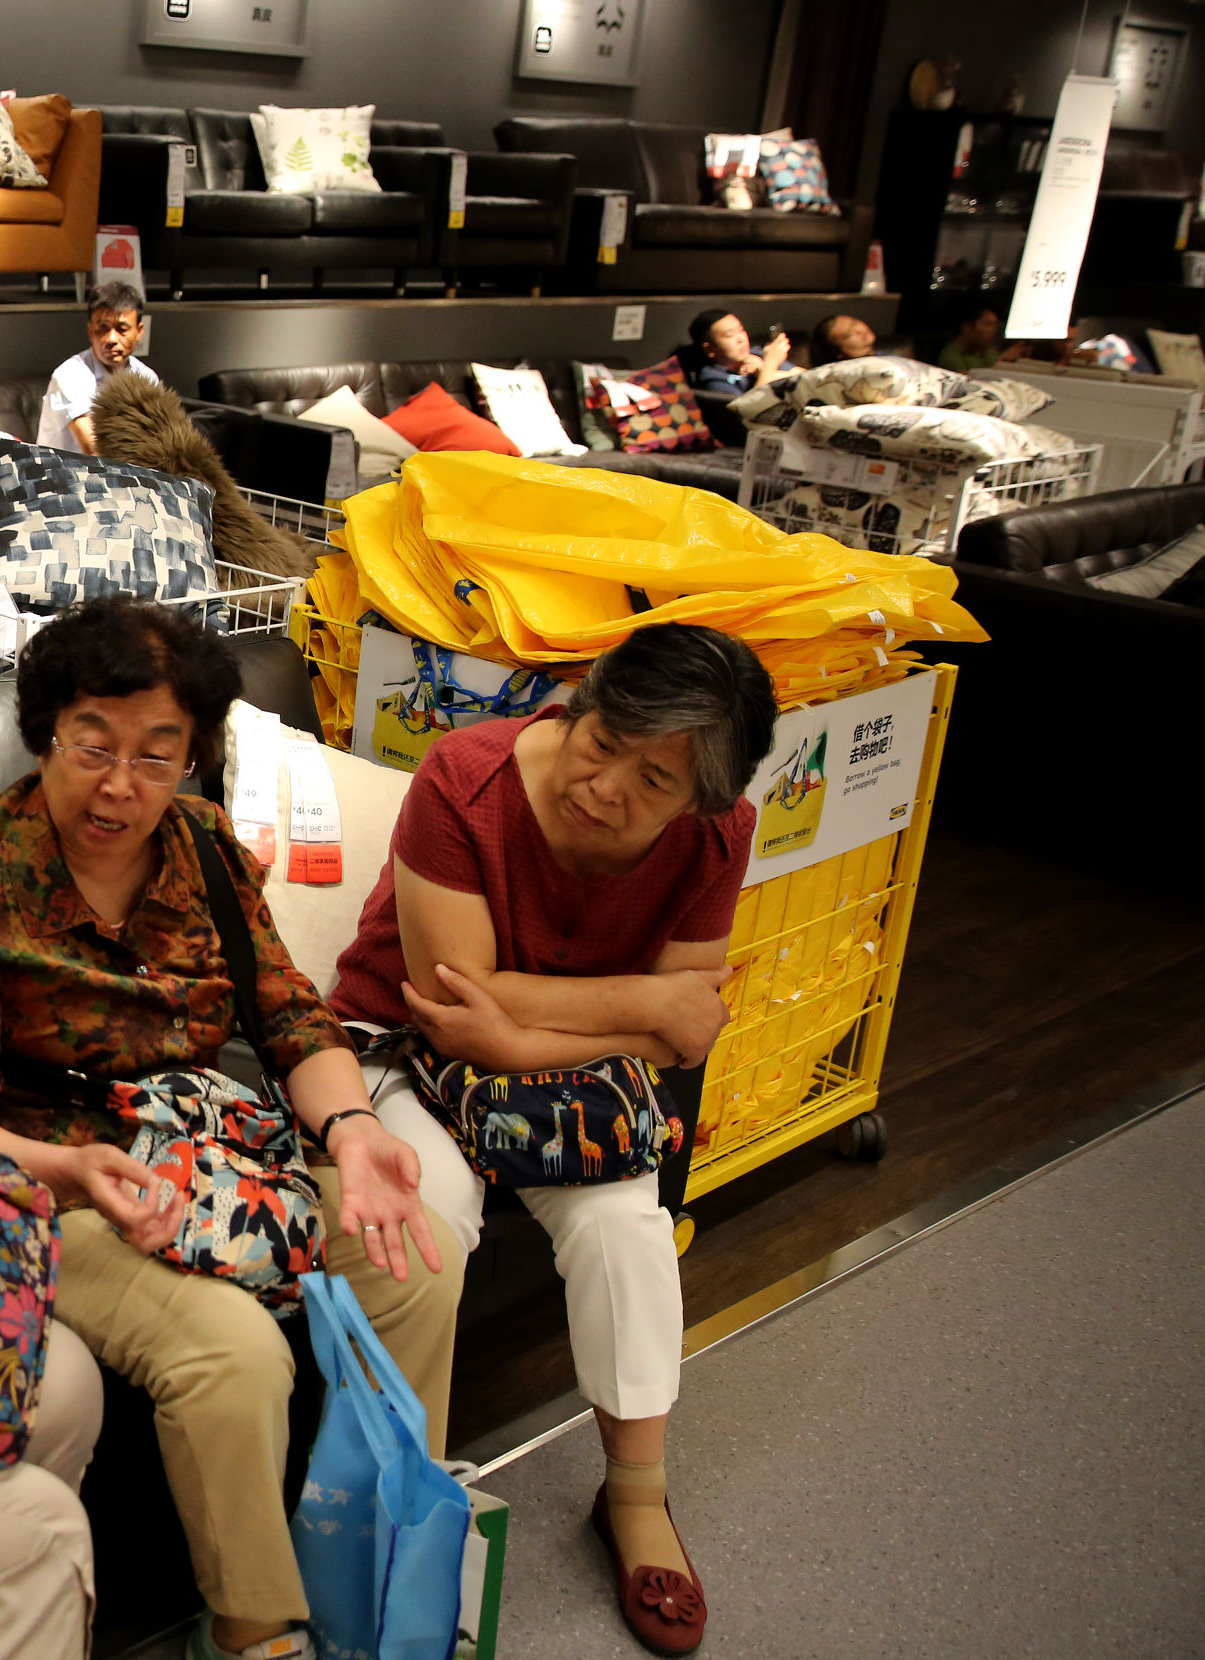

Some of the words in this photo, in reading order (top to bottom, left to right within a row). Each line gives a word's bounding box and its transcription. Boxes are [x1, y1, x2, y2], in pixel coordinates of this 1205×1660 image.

[845, 771, 866, 783] Borrow
[871, 763, 889, 776] yellow
[843, 787, 851, 796] go
